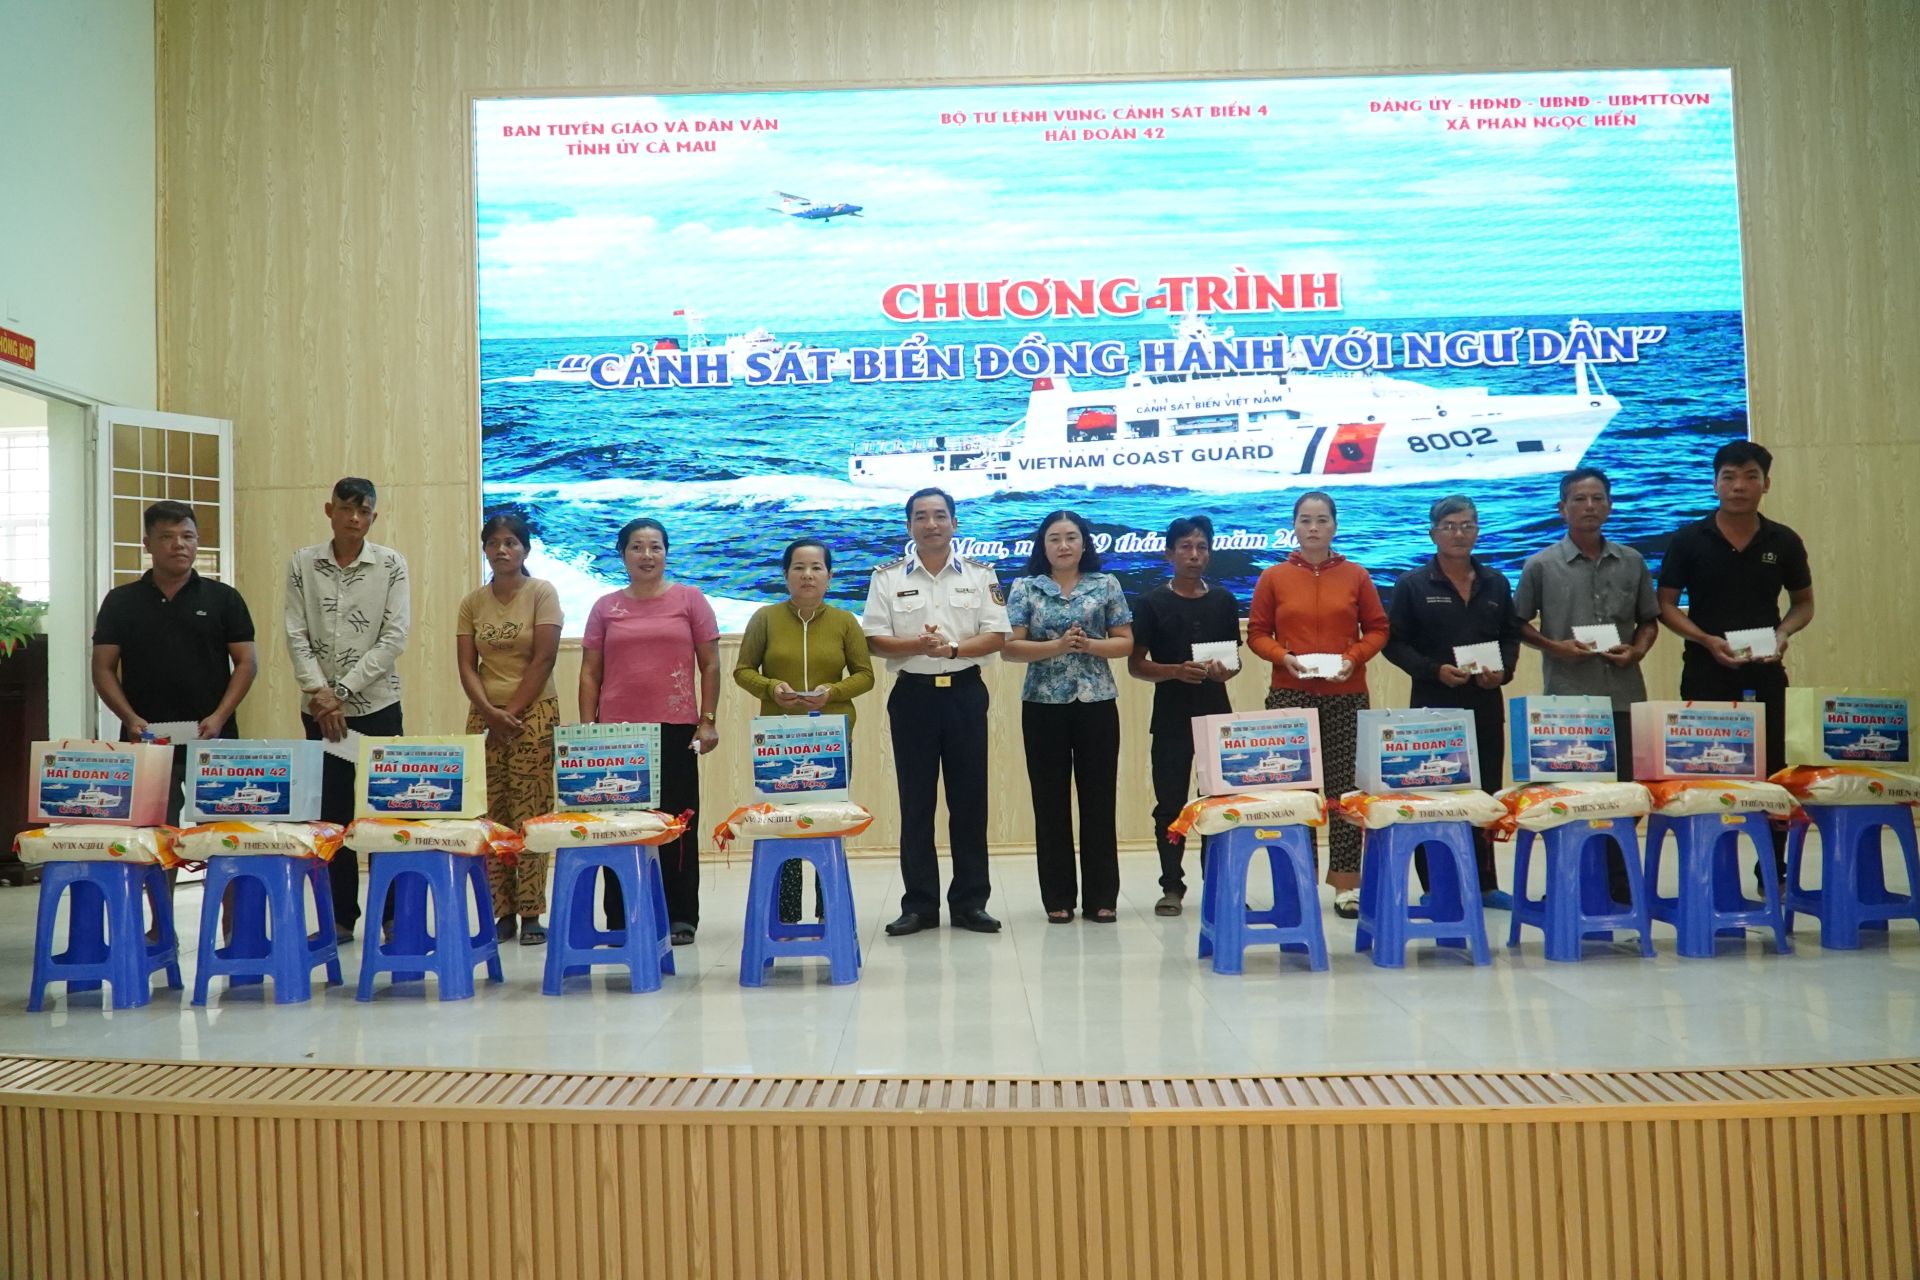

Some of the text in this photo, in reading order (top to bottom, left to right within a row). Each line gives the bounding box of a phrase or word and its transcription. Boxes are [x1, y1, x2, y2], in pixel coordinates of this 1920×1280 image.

[1469, 98, 1522, 110] HĐND
[1608, 93, 1711, 107] UBMTTQVN
[941, 111, 967, 126] BỘ
[973, 110, 998, 124] TƯ
[1002, 108, 1048, 125] LỆNH
[1054, 106, 1107, 122] VÙNG
[1113, 103, 1164, 120] CẢNH
[1171, 103, 1204, 119] SÁT
[1257, 104, 1269, 117] 4
[1447, 115, 1471, 130] XÃ
[1477, 117, 1527, 130] PHAN
[1533, 115, 1587, 131] NGỌC
[503, 117, 779, 137] BAN TUYÊN GIÁO VÀ DÂN VẬN
[1044, 125, 1166, 142] HẢI ĐOÀN 42
[566, 139, 611, 156] TỈNH
[646, 137, 671, 153] CÀ
[676, 139, 717, 153] MAU
[882, 267, 1340, 320] CHƯƠNG TRÌNH
[747, 341, 837, 383] SÁT
[850, 335, 962, 380] BIỂN
[977, 333, 1127, 378] ĐỒNG
[1141, 331, 1286, 373] HÀNH
[1299, 328, 1393, 369] VỚI
[1405, 327, 1523, 367] NGƯ
[1407, 427, 1498, 453] 8002
[1018, 444, 1274, 471] VIETNAM COAST GUARD
[1114, 531, 1167, 553] thán
[1211, 529, 1269, 551] năm
[1289, 735, 1306, 744] 42
[442, 764, 460, 773] 42
[628, 755, 646, 765] 42
[113, 771, 130, 781] 42
